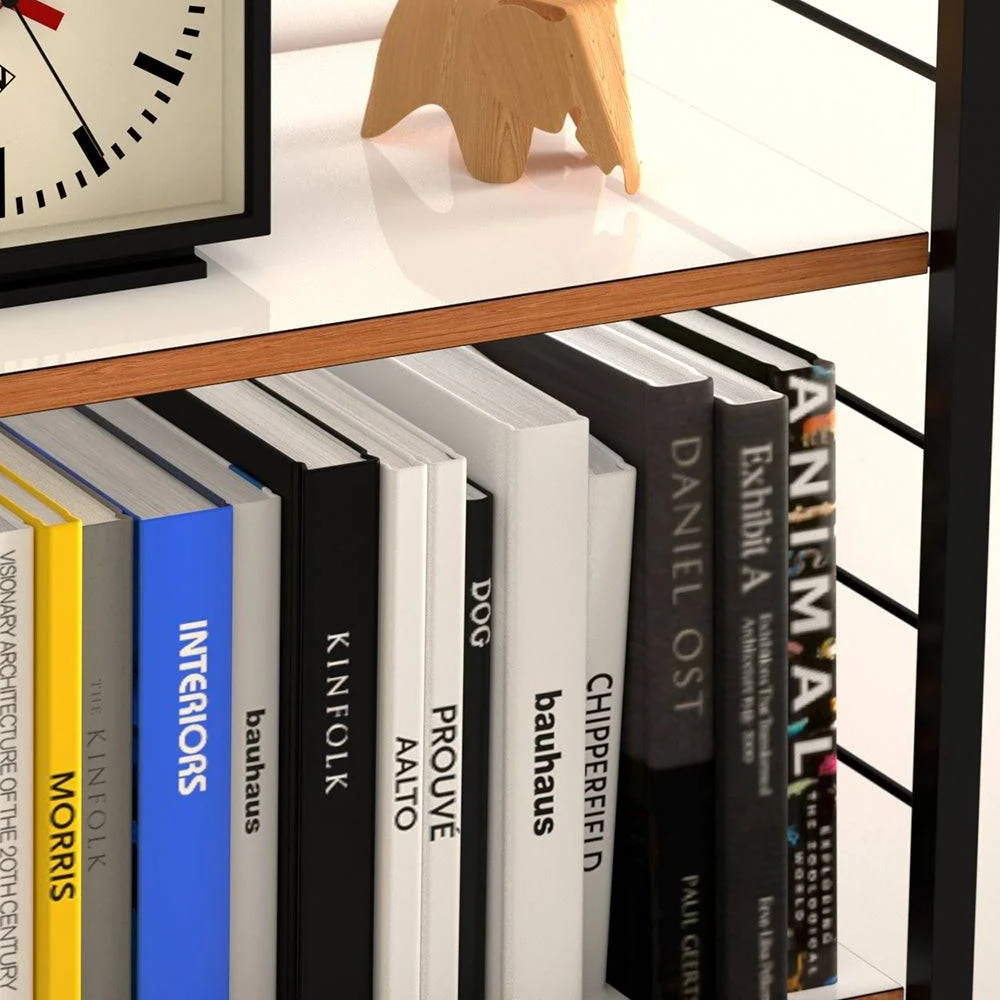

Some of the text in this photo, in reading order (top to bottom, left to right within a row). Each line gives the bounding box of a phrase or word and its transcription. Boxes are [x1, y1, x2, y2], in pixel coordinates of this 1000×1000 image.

[671, 436, 703, 715] DANIEL OST
[740, 442, 773, 595] Exhibit A
[788, 374, 833, 778] ANIMAL
[470, 578, 492, 648] DOG
[0, 551, 19, 991] VISIONARY ARCHITECTURE OF THE 20TH CENTURY
[178, 619, 209, 796] INTERIORS
[245, 708, 267, 834] bauhaus
[325, 631, 350, 795] KINFOLK
[429, 704, 460, 843] PROUVÉ
[534, 689, 563, 837] bauhaus
[50, 771, 76, 902] MORRIS
[87, 729, 107, 873] KINFOLK
[394, 737, 419, 831] AALTO
[806, 790, 818, 829] THE
